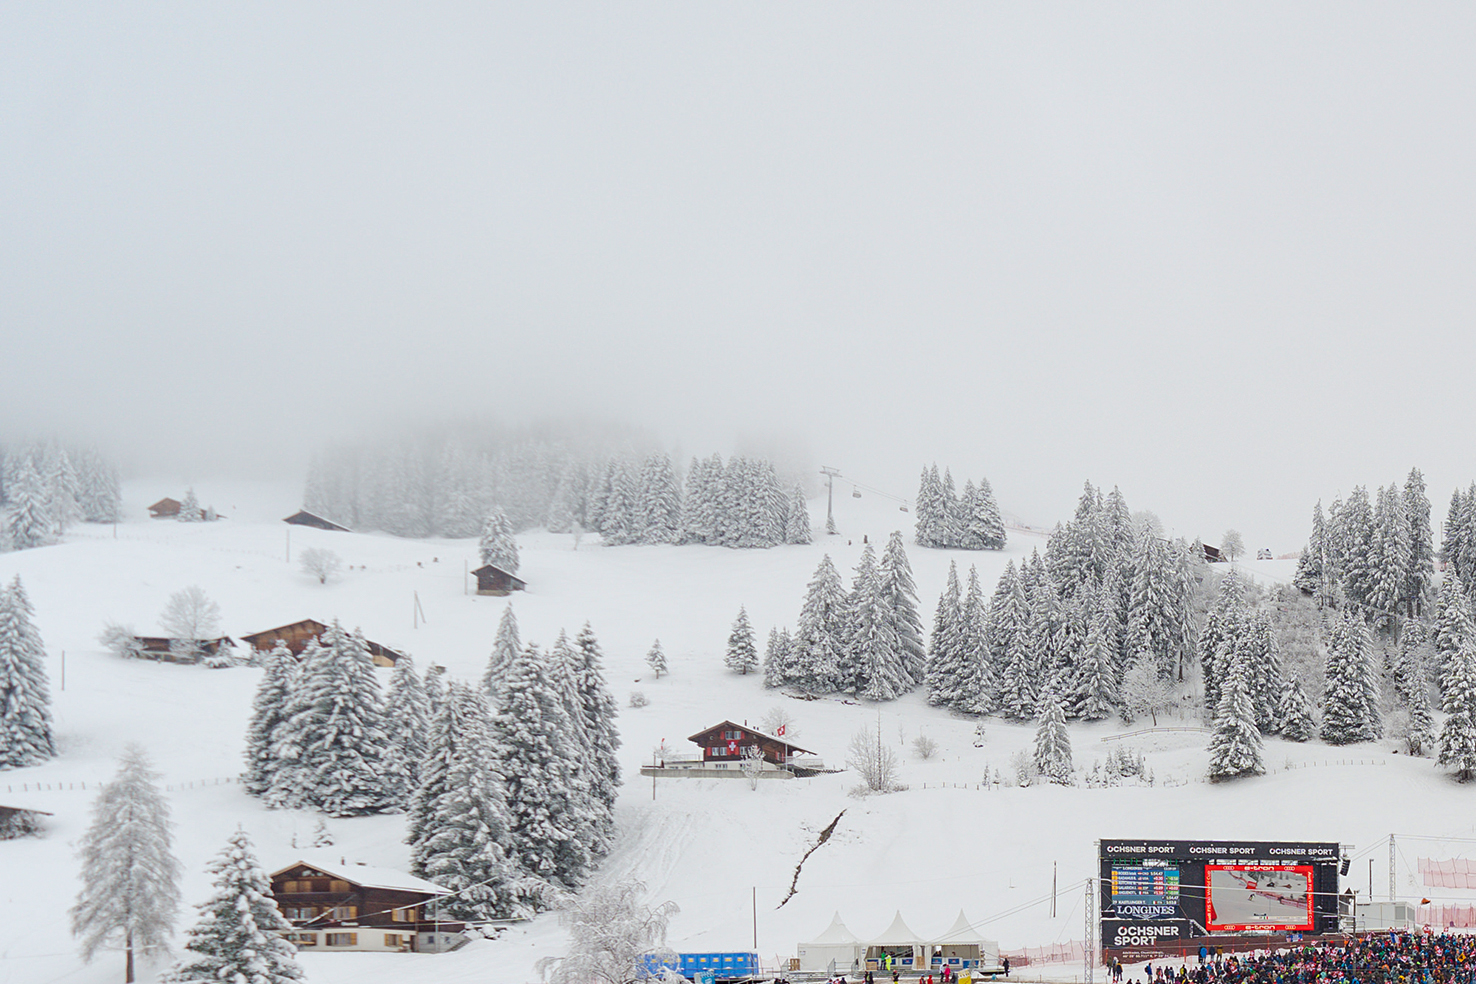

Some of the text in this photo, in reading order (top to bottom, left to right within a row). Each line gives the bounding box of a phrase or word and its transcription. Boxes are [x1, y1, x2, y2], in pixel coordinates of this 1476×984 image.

[1107, 845, 1175, 854] OCHSNER SPORT
[1189, 846, 1256, 855] OCHSNER SPORT
[1307, 848, 1334, 856] SPORT
[1117, 906, 1175, 914] LONGINES
[1118, 926, 1180, 936] OCHSNER
[1114, 936, 1156, 946] SPORT
